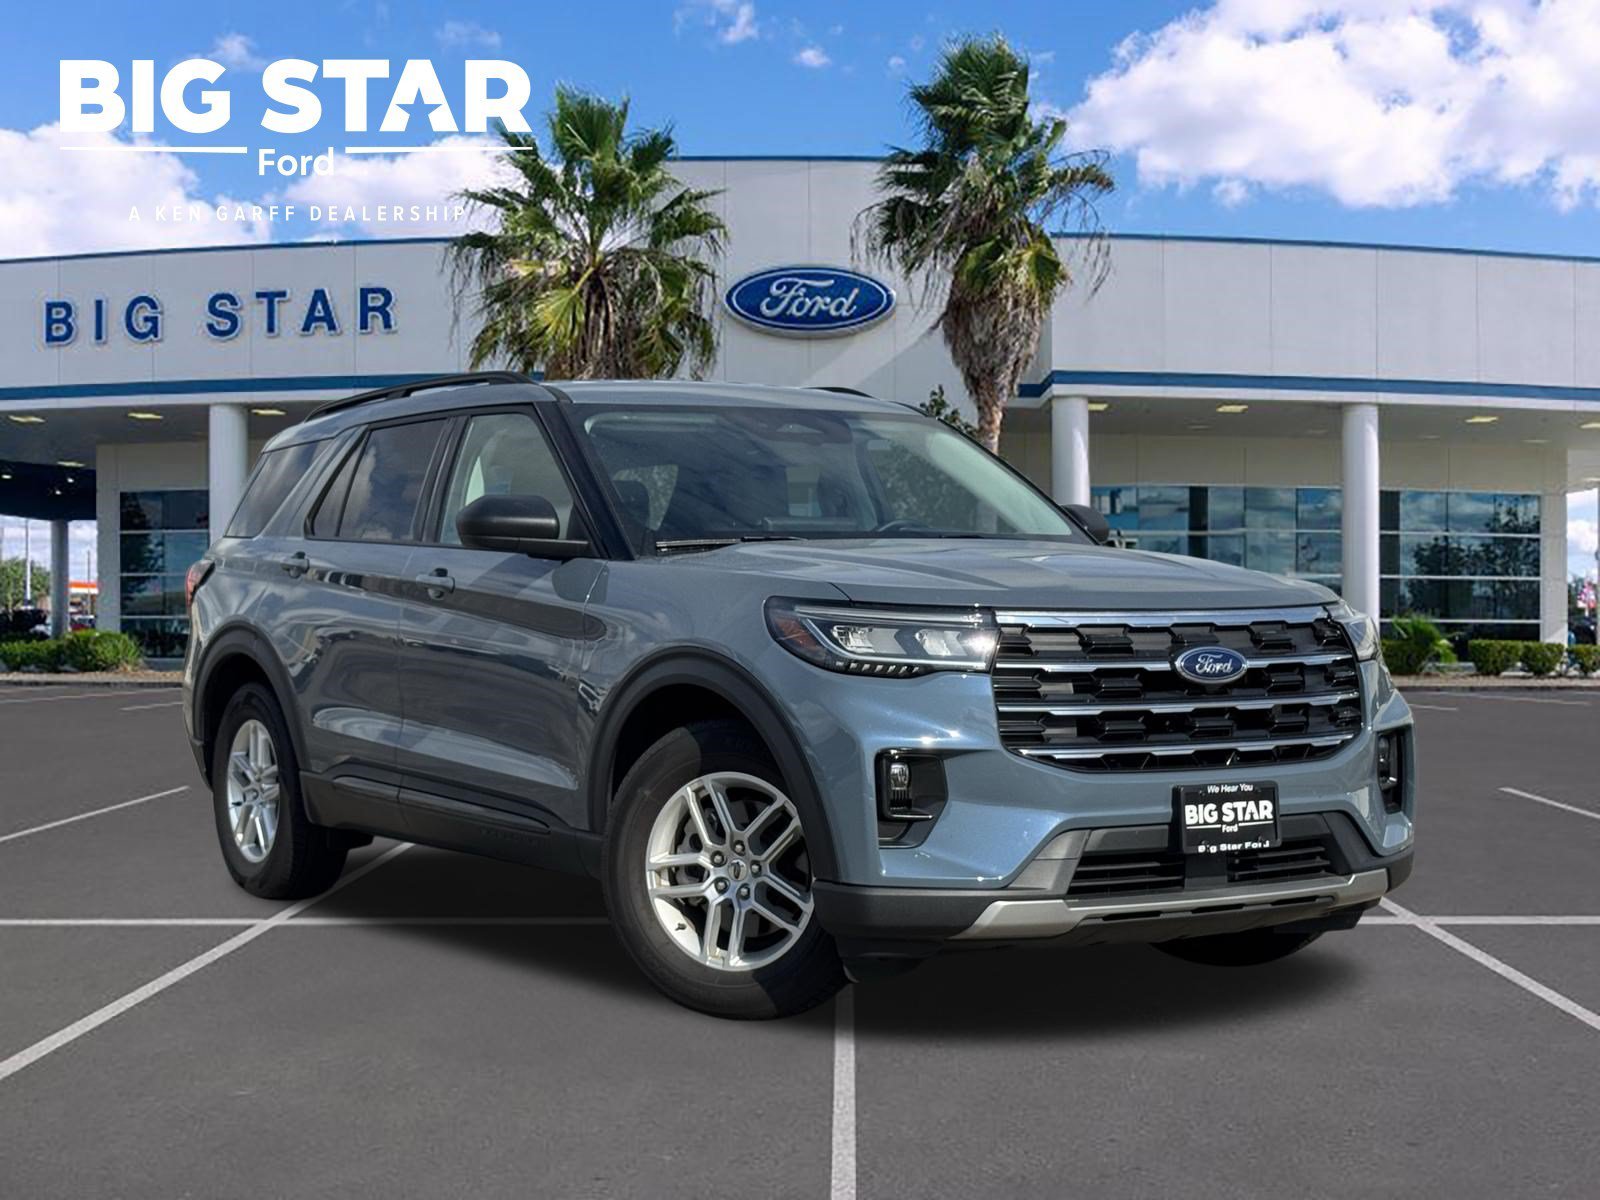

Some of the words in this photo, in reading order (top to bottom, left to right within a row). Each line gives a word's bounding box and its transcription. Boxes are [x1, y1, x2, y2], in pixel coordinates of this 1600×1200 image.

[759, 277, 858, 318] Ford
[45, 294, 163, 345] BIG
[205, 285, 397, 341] STAR
[1195, 653, 1234, 675] Ford
[1207, 785, 1220, 794] We
[1220, 784, 1239, 793] Hear
[1239, 783, 1254, 792] You
[1184, 803, 1218, 825] BIG
[1221, 800, 1274, 822] STAR
[1221, 823, 1239, 833] Ford
[1219, 843, 1243, 852] Star
